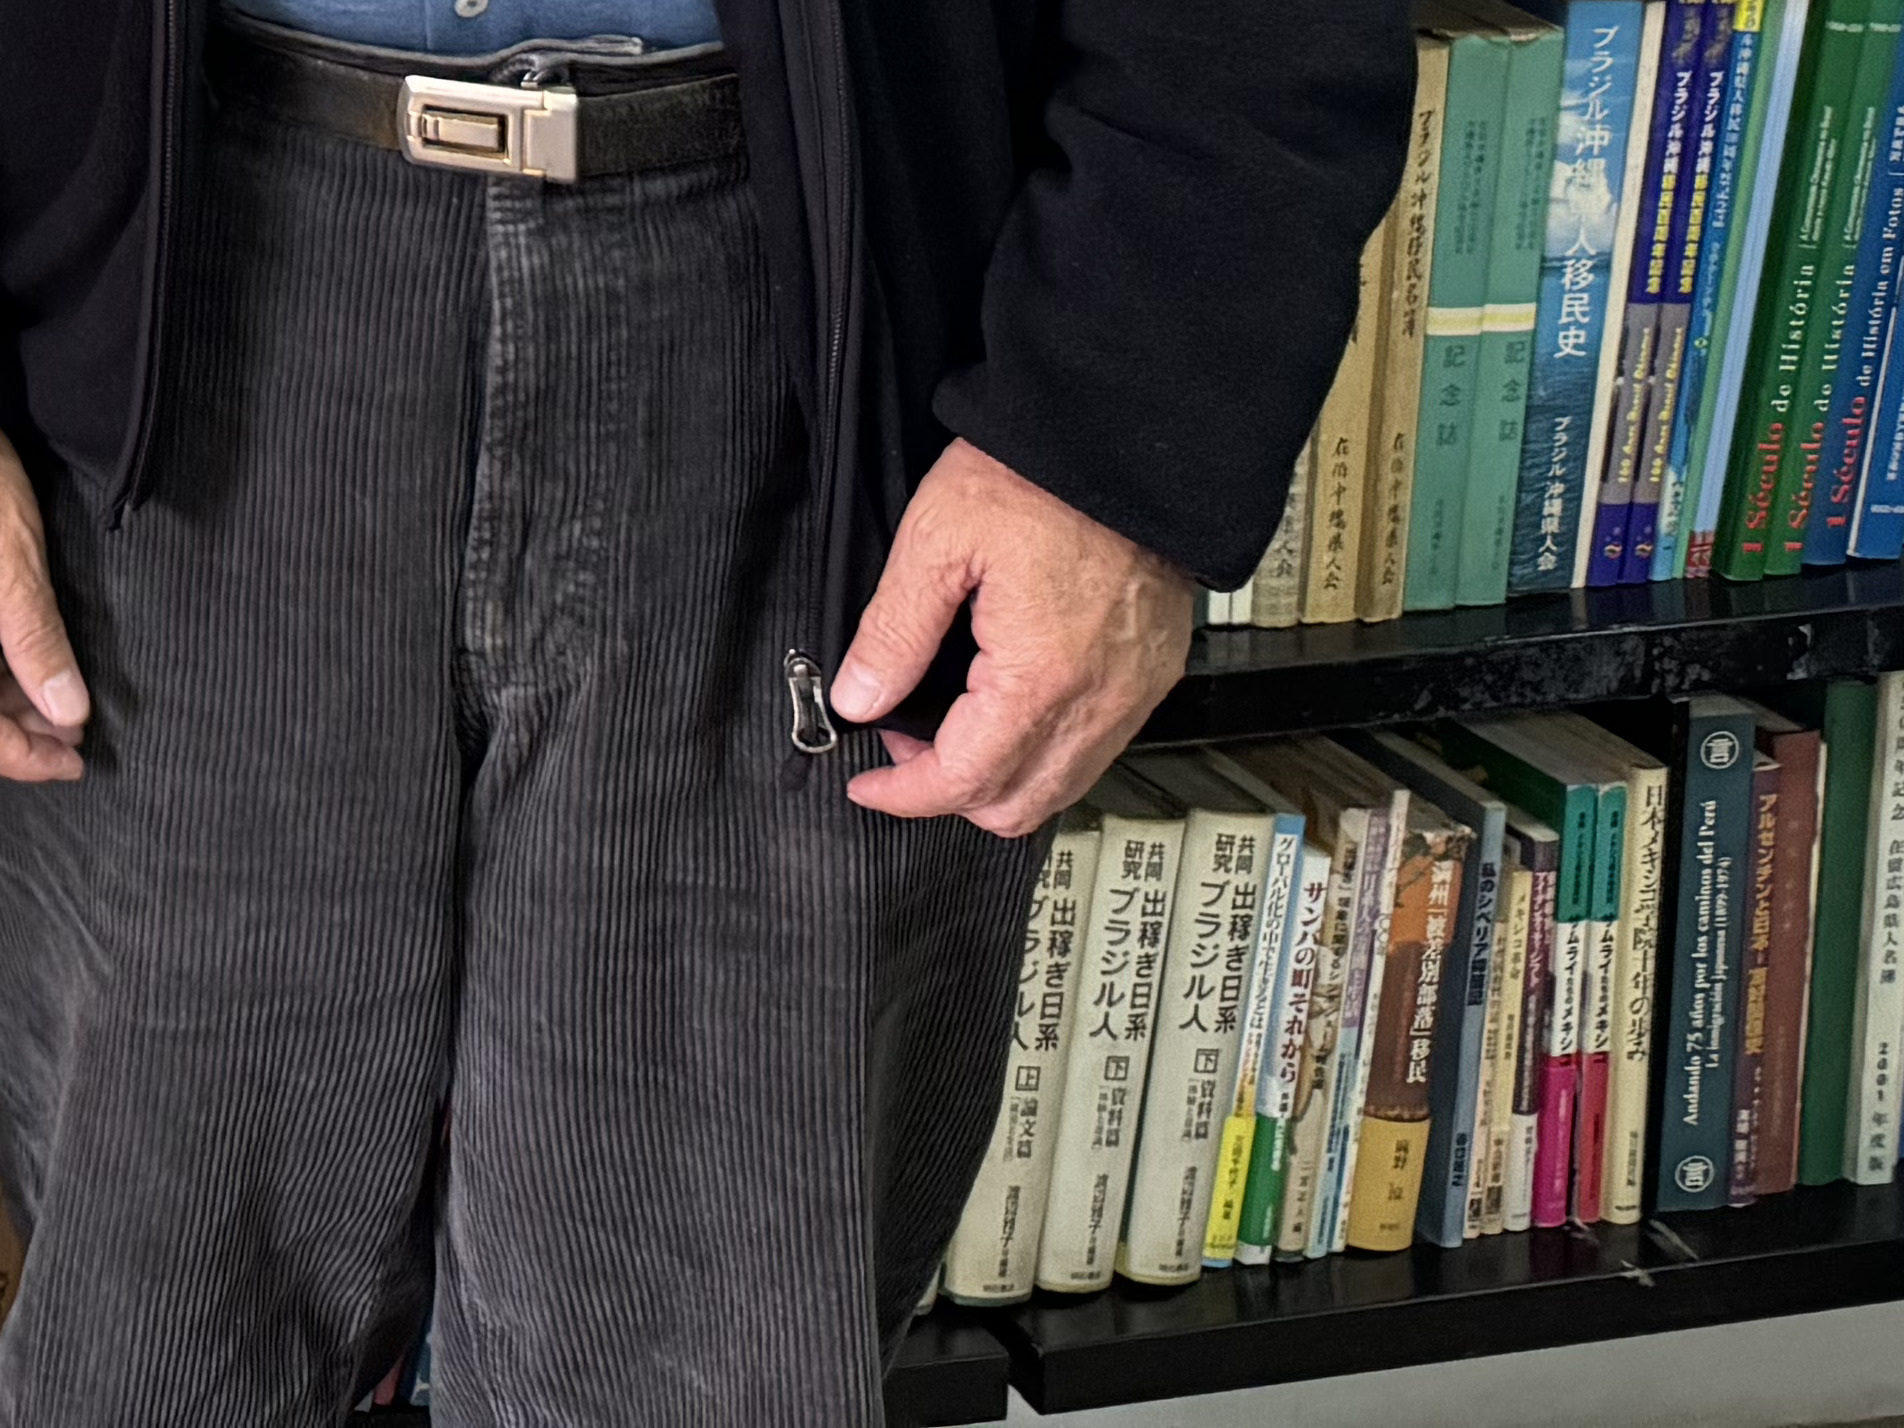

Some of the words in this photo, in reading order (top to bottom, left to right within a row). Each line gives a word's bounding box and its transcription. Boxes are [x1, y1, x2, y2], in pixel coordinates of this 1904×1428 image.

[1882, 187, 1902, 240] Fotos
[1877, 247, 1893, 275] em
[1779, 265, 1816, 370] História
[1820, 264, 1855, 370] História
[1863, 281, 1889, 358] História
[1771, 385, 1793, 412] de
[1814, 385, 1834, 412] de
[1857, 364, 1874, 386] de
[1745, 422, 1784, 529] Século
[1788, 422, 1825, 529] Século
[1831, 397, 1865, 504] Século
[1536, 415, 1571, 572] ブラジル沖縄県人会
[1742, 542, 1764, 554] 1
[1698, 800, 1717, 837] Perú
[1053, 851, 1073, 889] 共同
[1145, 842, 1165, 882] 共同
[1236, 836, 1256, 875] 共同
[1696, 841, 1714, 864] del
[1694, 869, 1712, 932] caminos
[1036, 900, 1076, 1051] 出稼ぎ日系
[1089, 888, 1136, 1040] ブラジル人
[1125, 891, 1166, 1042] 出稼ぎ日系
[1179, 881, 1230, 1033] ブラジル人
[1214, 883, 1257, 1033] 出稼ぎ日系
[1691, 936, 1709, 958] los
[1693, 963, 1711, 988] por
[1279, 882, 1326, 1084] サンバの町それから
[1691, 993, 1705, 1028] años
[1686, 1032, 1704, 1052] 75
[1683, 1056, 1701, 1125] Andando
